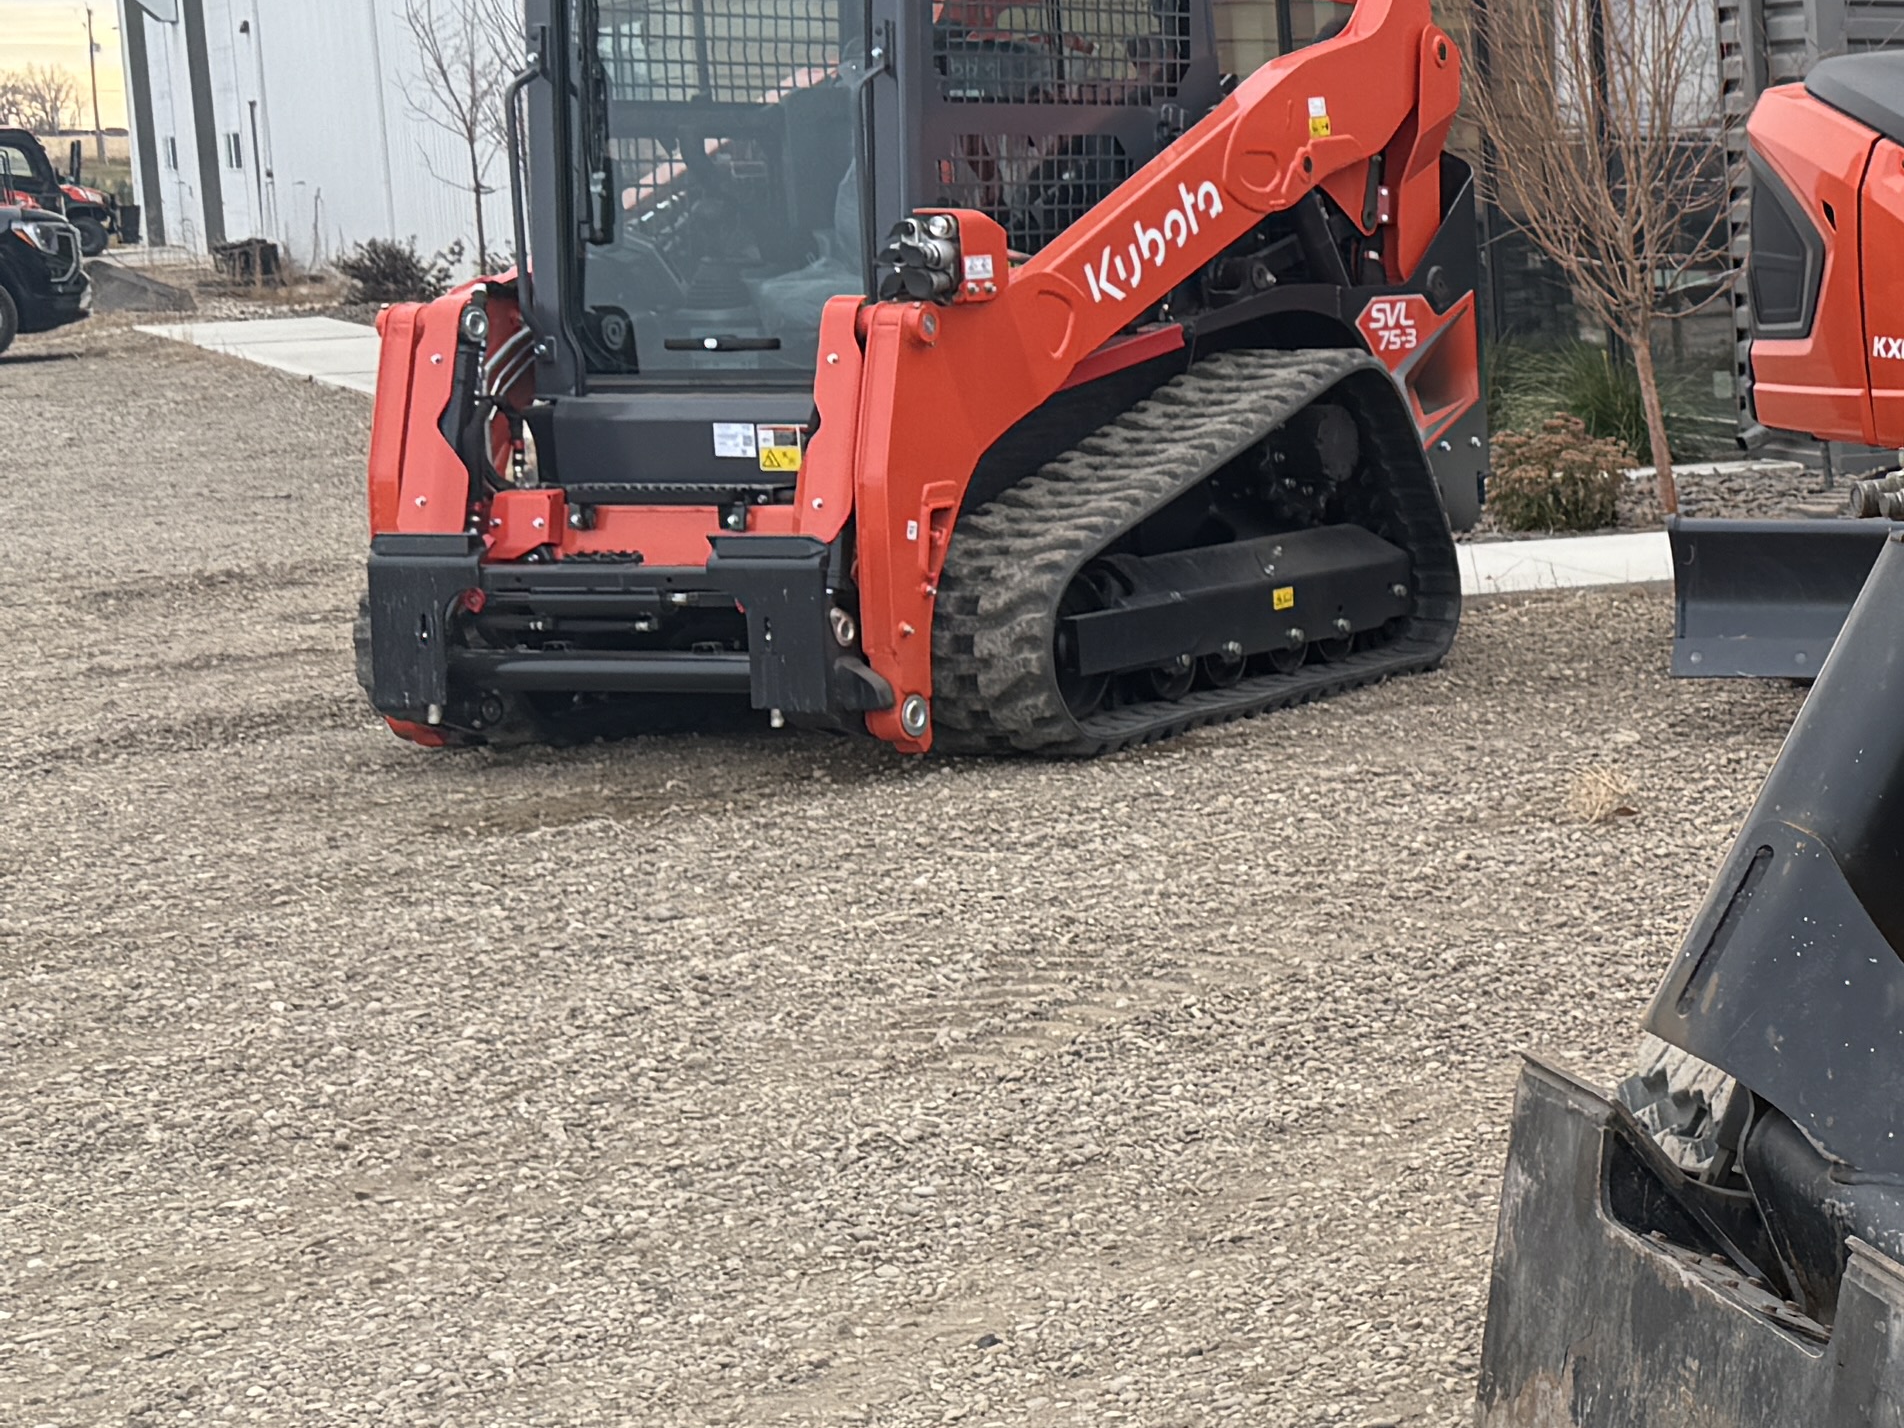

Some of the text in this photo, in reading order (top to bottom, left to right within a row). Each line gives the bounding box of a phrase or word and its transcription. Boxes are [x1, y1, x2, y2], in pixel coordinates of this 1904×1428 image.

[1082, 179, 1226, 303] Kubota
[1369, 300, 1416, 330] SVL
[1378, 328, 1418, 352] 75-3
